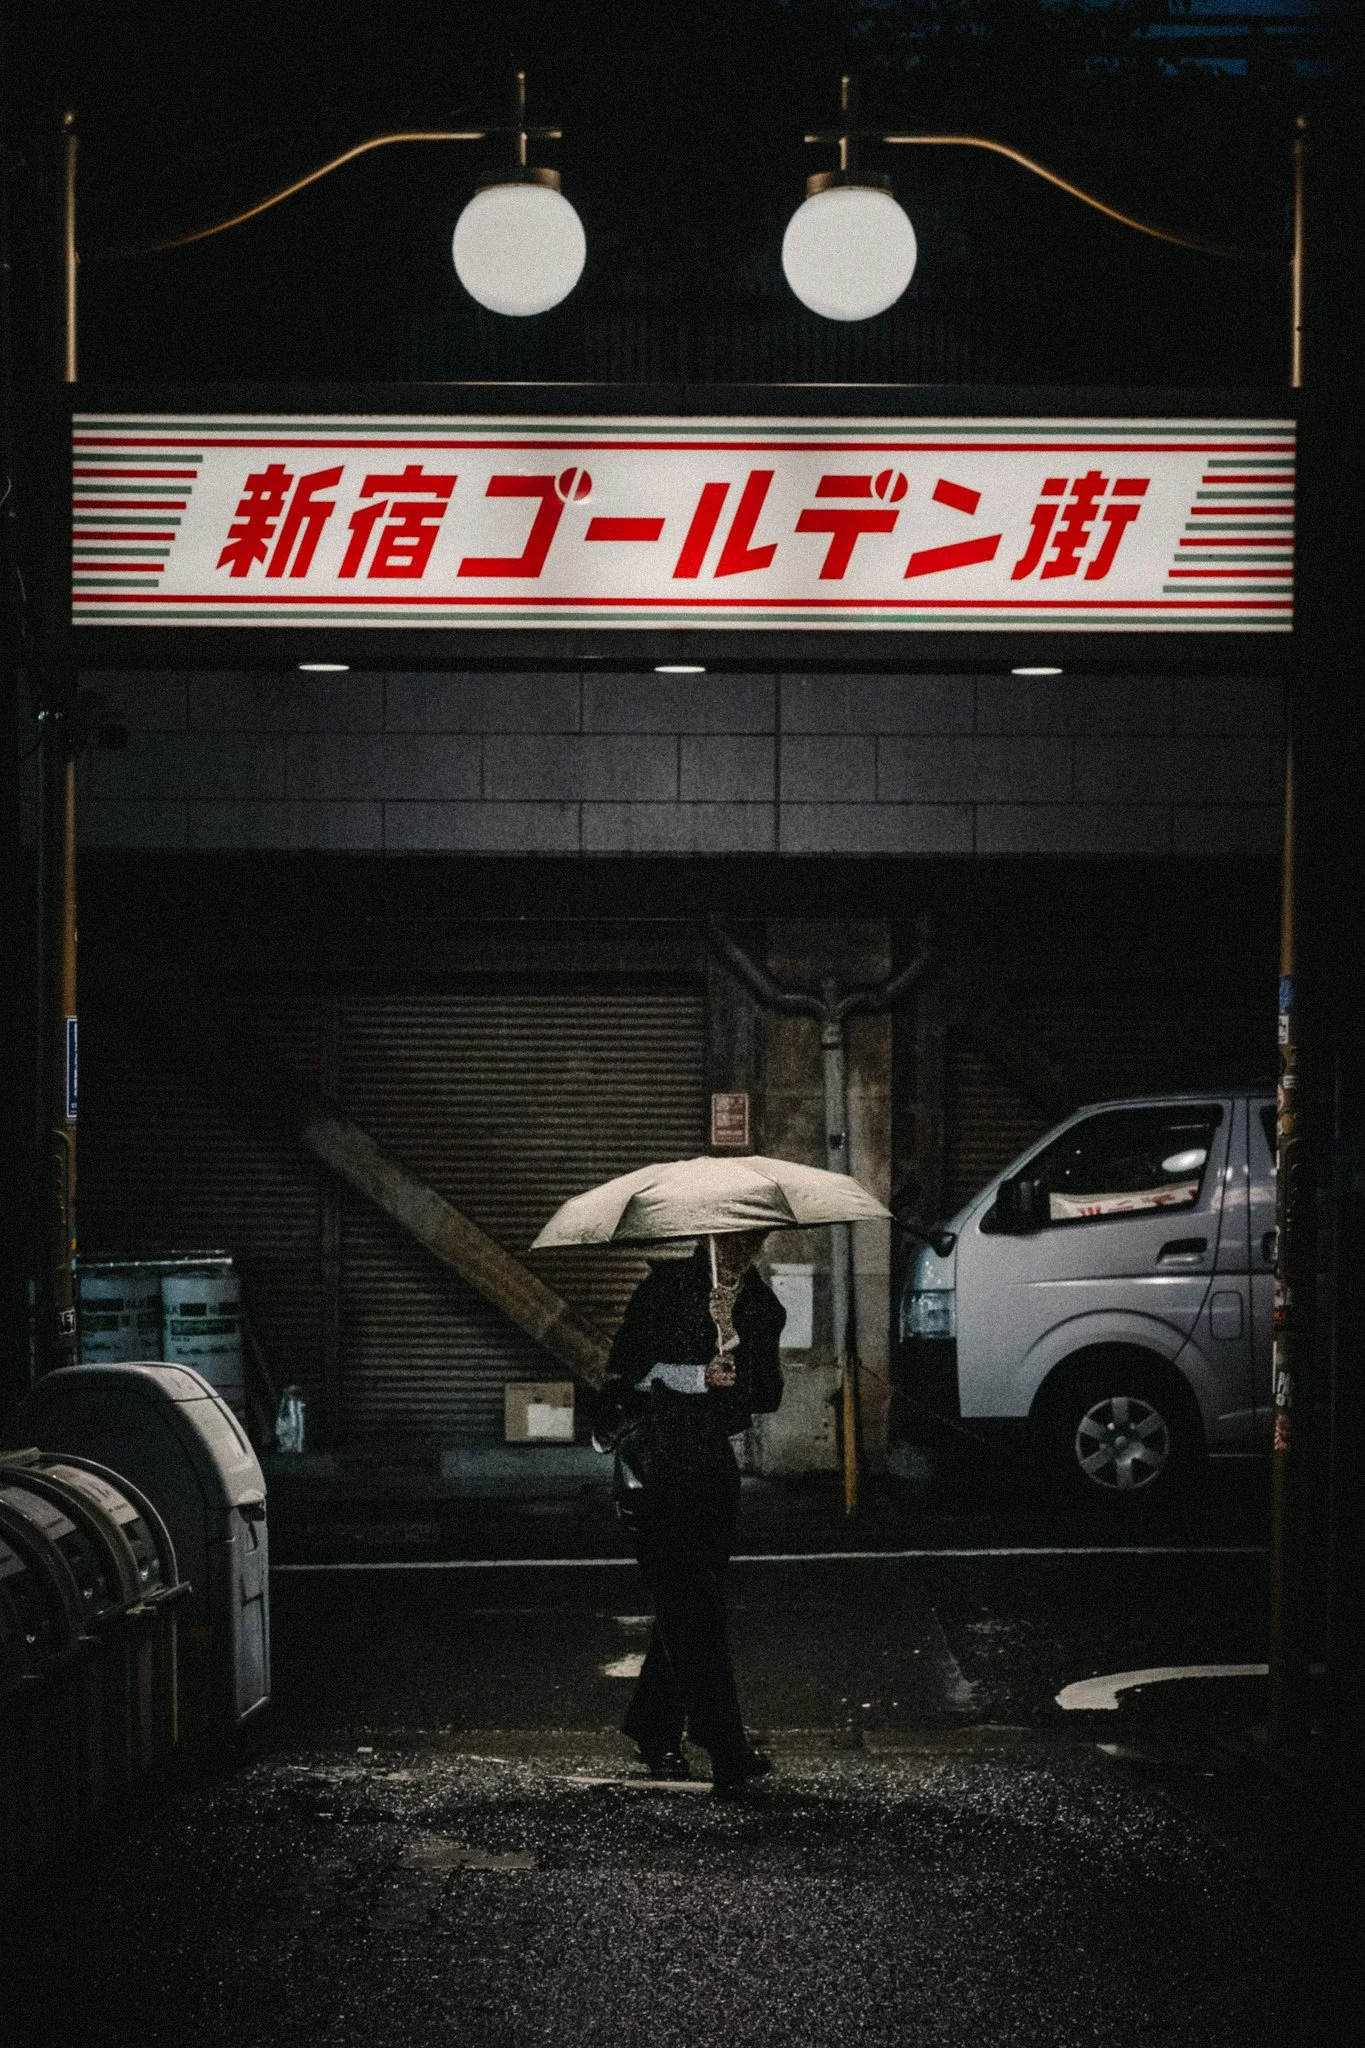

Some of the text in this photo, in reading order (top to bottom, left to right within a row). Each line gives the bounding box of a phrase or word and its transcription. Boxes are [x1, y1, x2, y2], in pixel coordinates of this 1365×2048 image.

[217, 463, 1149, 580] 新宿ゴールデン街
